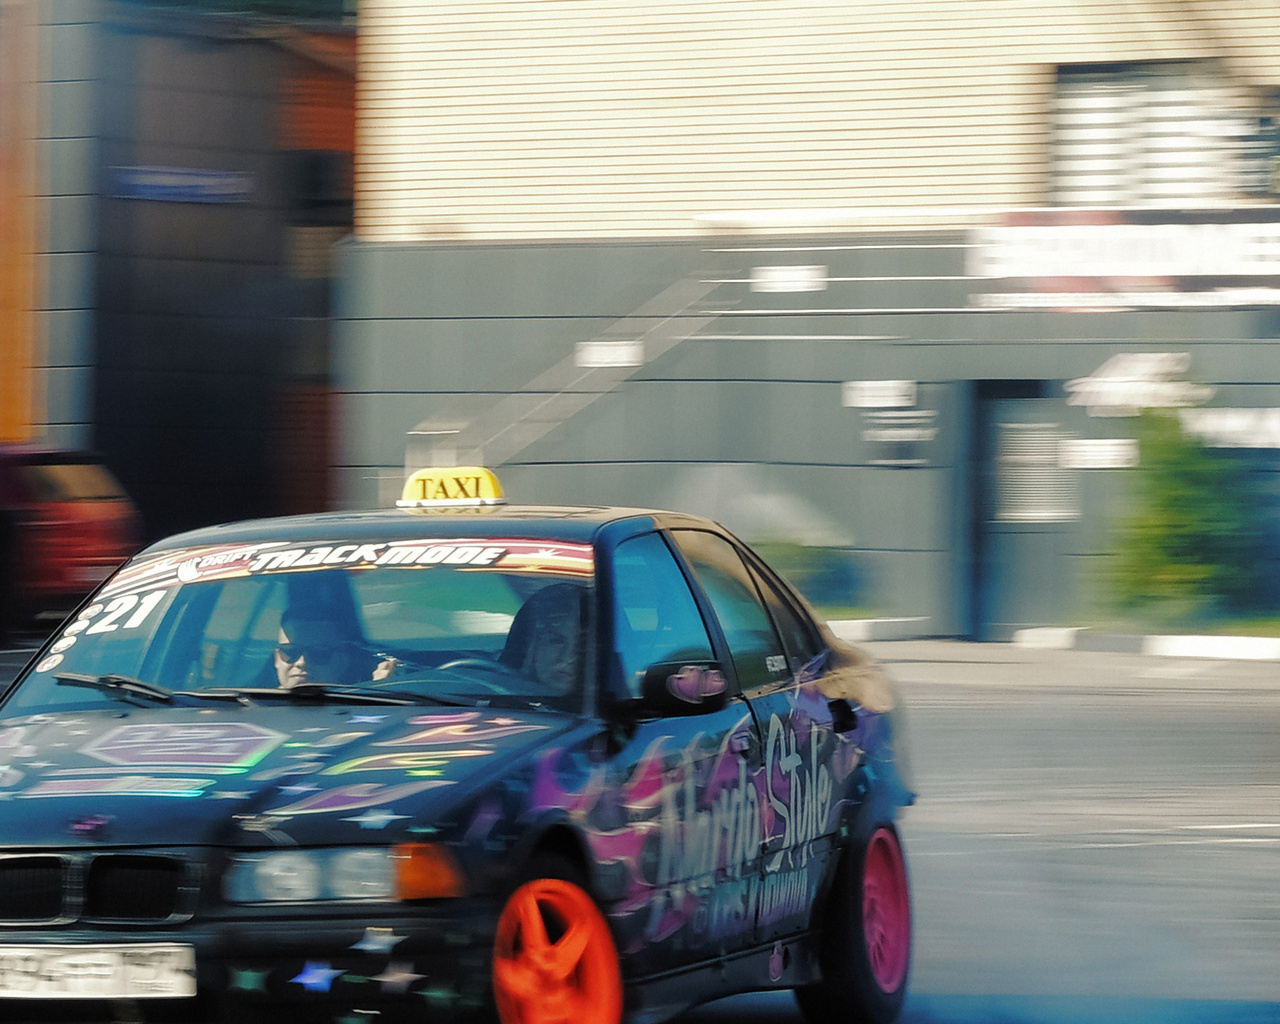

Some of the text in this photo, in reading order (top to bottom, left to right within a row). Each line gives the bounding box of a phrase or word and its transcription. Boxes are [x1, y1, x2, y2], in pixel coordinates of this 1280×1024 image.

[415, 476, 482, 500] TAXI
[198, 551, 254, 569] DRIFT
[85, 589, 168, 636] 21
[765, 712, 833, 872] Style
